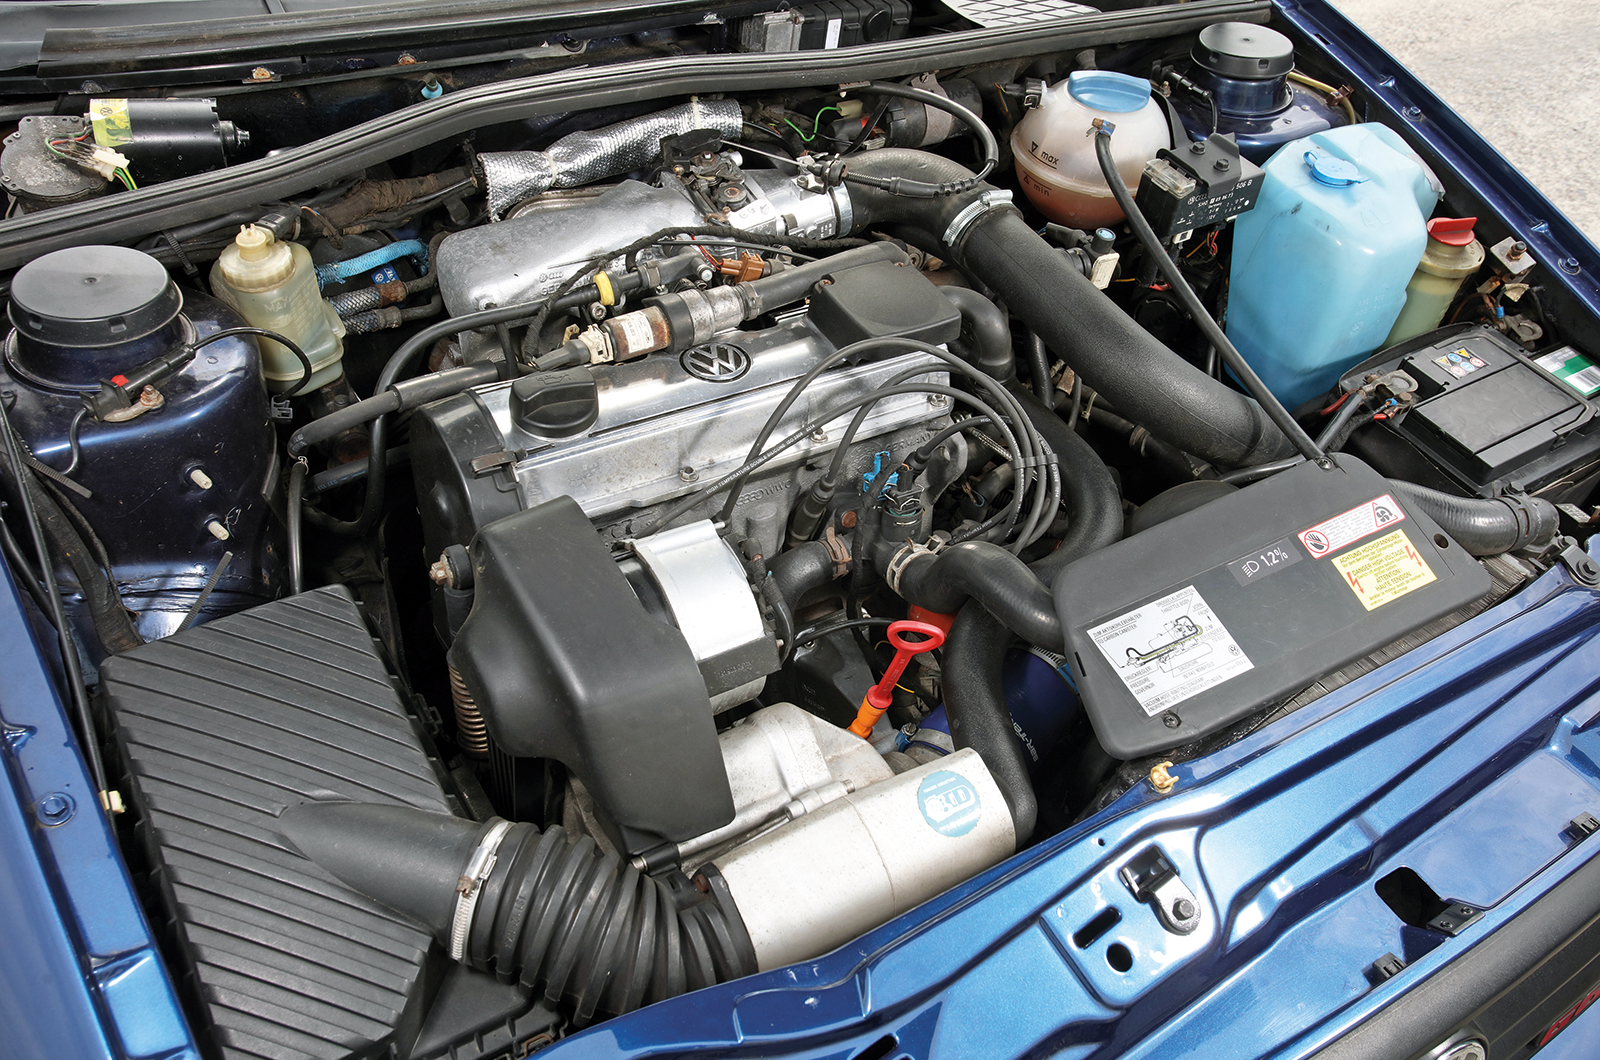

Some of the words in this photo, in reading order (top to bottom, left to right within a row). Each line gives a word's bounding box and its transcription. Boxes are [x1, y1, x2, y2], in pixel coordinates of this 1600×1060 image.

[1041, 151, 1059, 165] max
[1034, 184, 1050, 196] min
[706, 485, 719, 494] HIGH
[718, 466, 751, 488] TEMPERATURE
[750, 454, 768, 468] DOUBLE
[1340, 549, 1362, 564] ACHTUNG
[1360, 532, 1400, 554] HOCHSPANNUNG
[1260, 546, 1289, 567] 1.2%
[1352, 562, 1372, 576] DANGER
[1371, 557, 1384, 567] HIGH
[1383, 548, 1406, 561] VOLTAGE
[1374, 580, 1392, 592] HAUTE
[1391, 571, 1412, 585] TENSION
[1376, 568, 1401, 584] ATTENTION
[1160, 604, 1180, 614] THROTTLE
[1180, 598, 1190, 608] BODY
[1092, 630, 1102, 638] ZUM
[1104, 632, 1120, 642] CARBON
[1120, 624, 1138, 638] CANISTER
[1124, 666, 1152, 682] DRUCKREGLER
[1196, 661, 1215, 673] MANIFOLD
[1130, 676, 1151, 690] PRESSURE
[1134, 682, 1156, 695] GOVERNOR
[1144, 697, 1161, 708] VACUUM
[1160, 692, 1171, 701] HOSE
[1170, 684, 1187, 696] ROUTING
[1186, 676, 1204, 688] DIAGRAM
